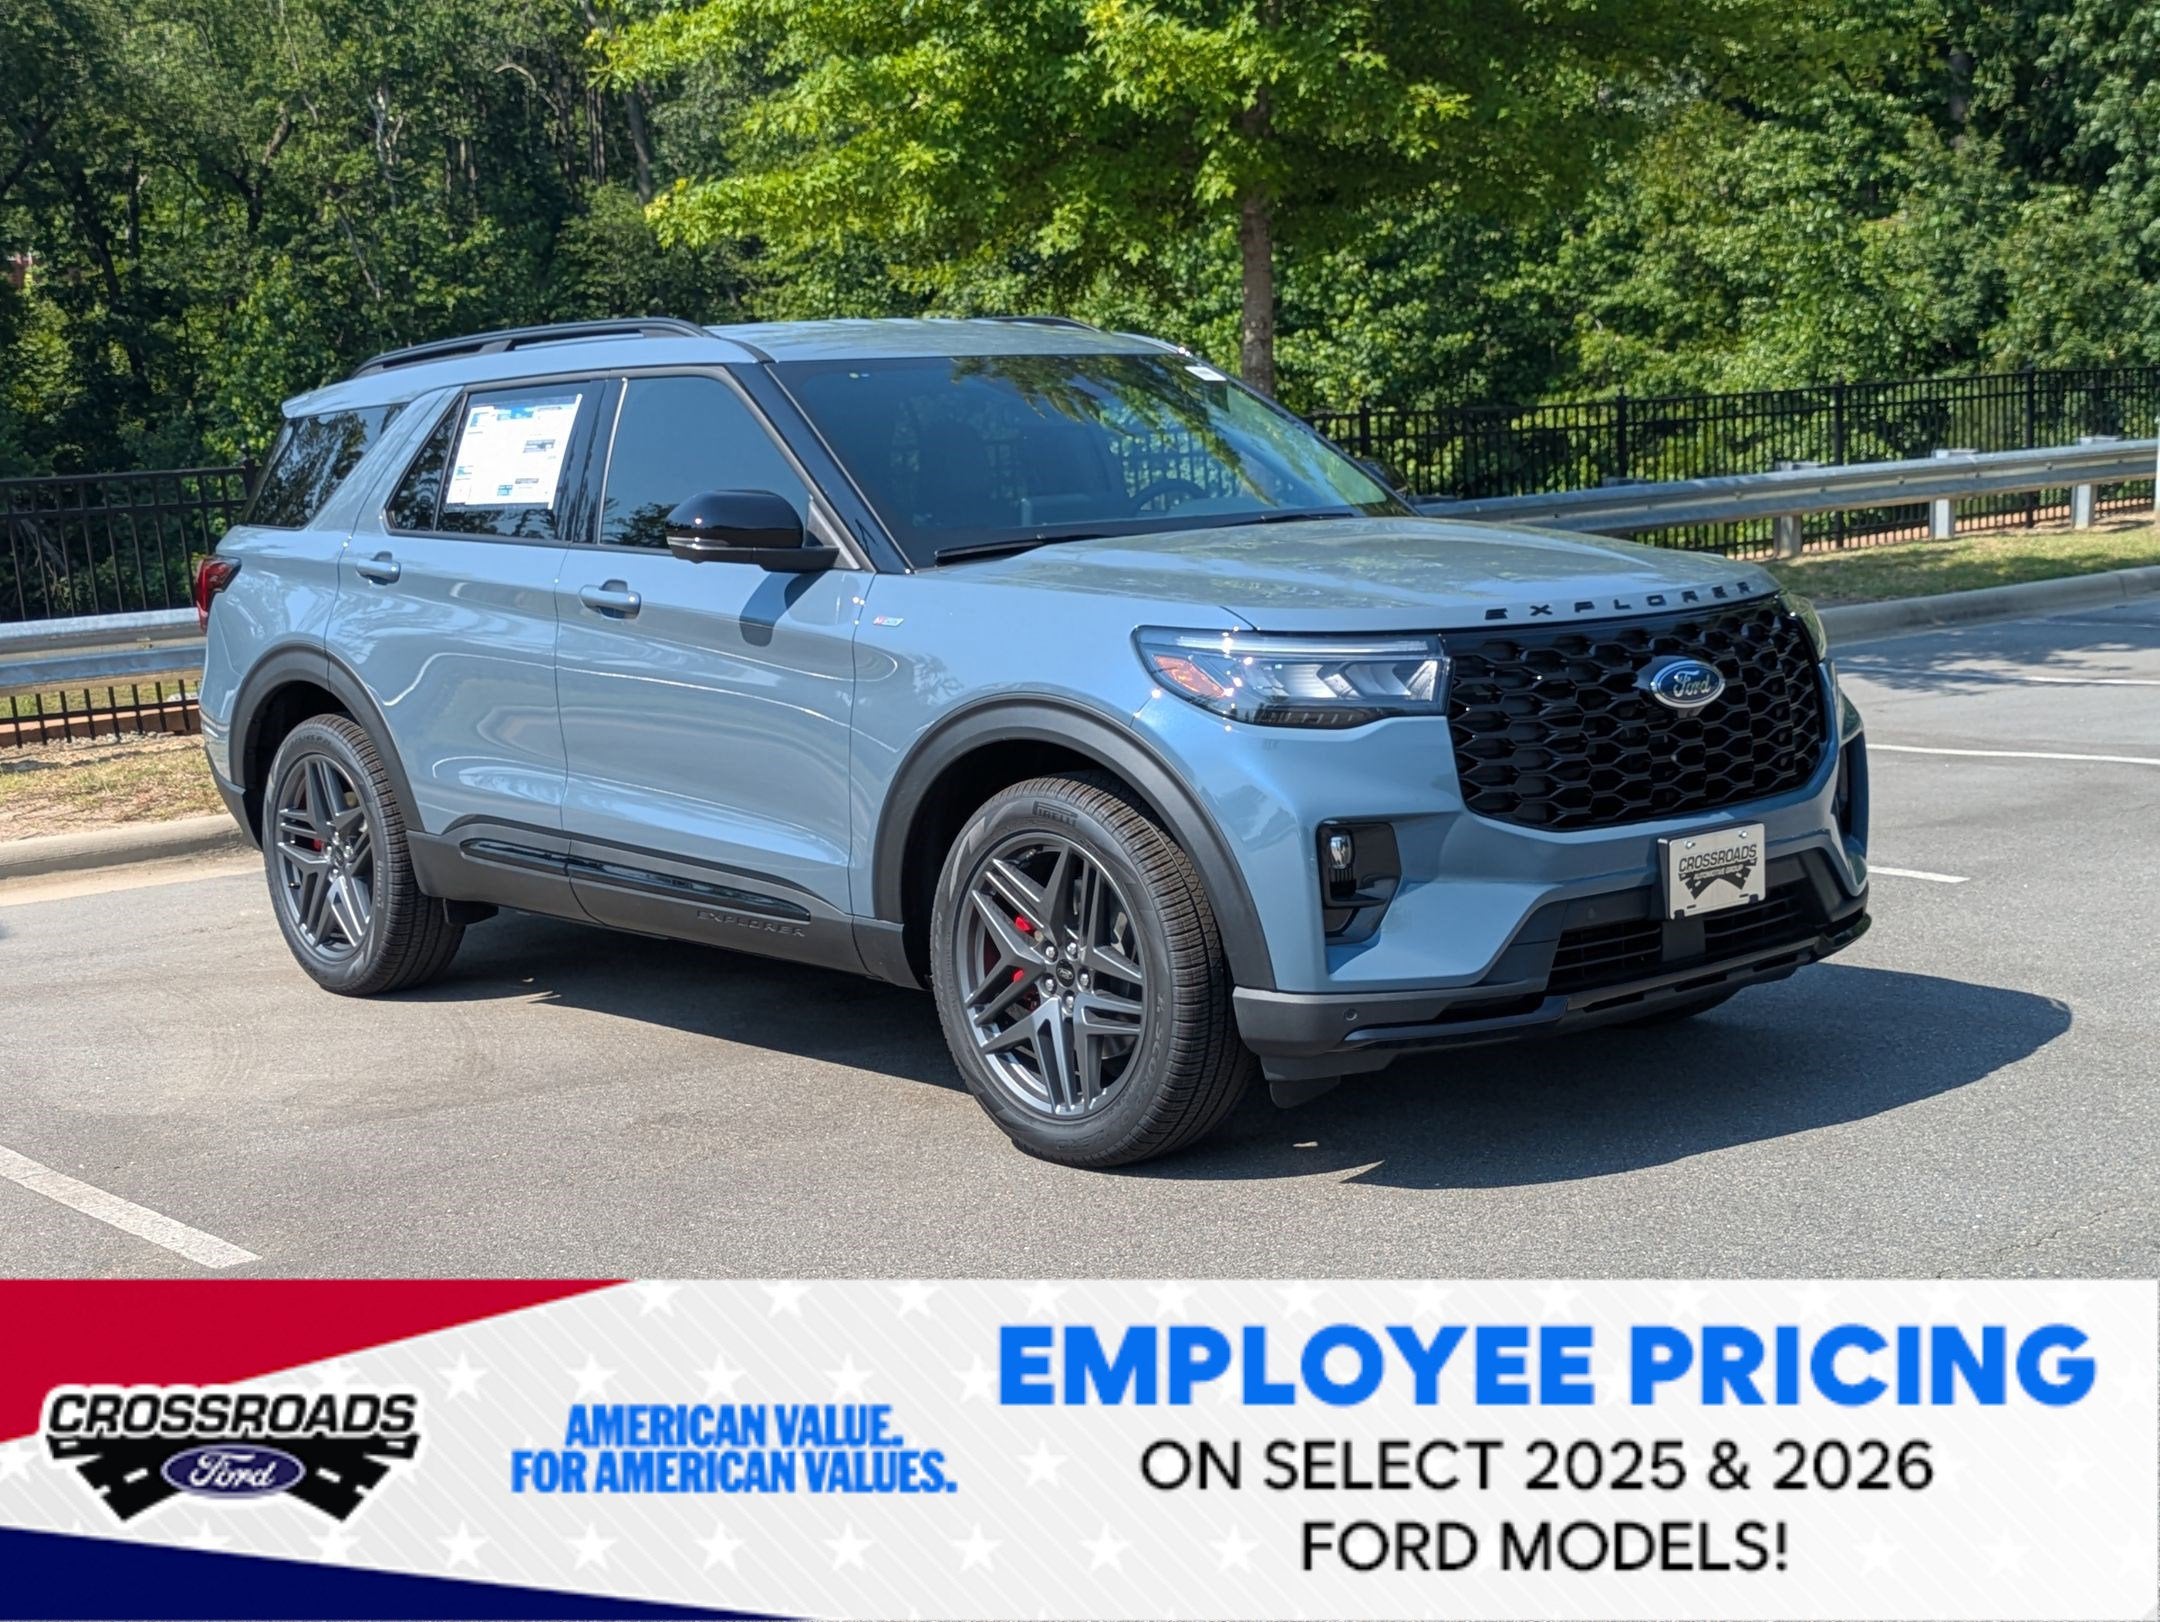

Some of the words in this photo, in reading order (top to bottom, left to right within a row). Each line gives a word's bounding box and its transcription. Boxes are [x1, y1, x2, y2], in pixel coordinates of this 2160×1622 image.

[1485, 581, 1751, 620] EXPLORER
[1672, 669, 1712, 698] Ford
[1678, 844, 1758, 873] CROSSROADS
[696, 909, 806, 937] EXPLORER
